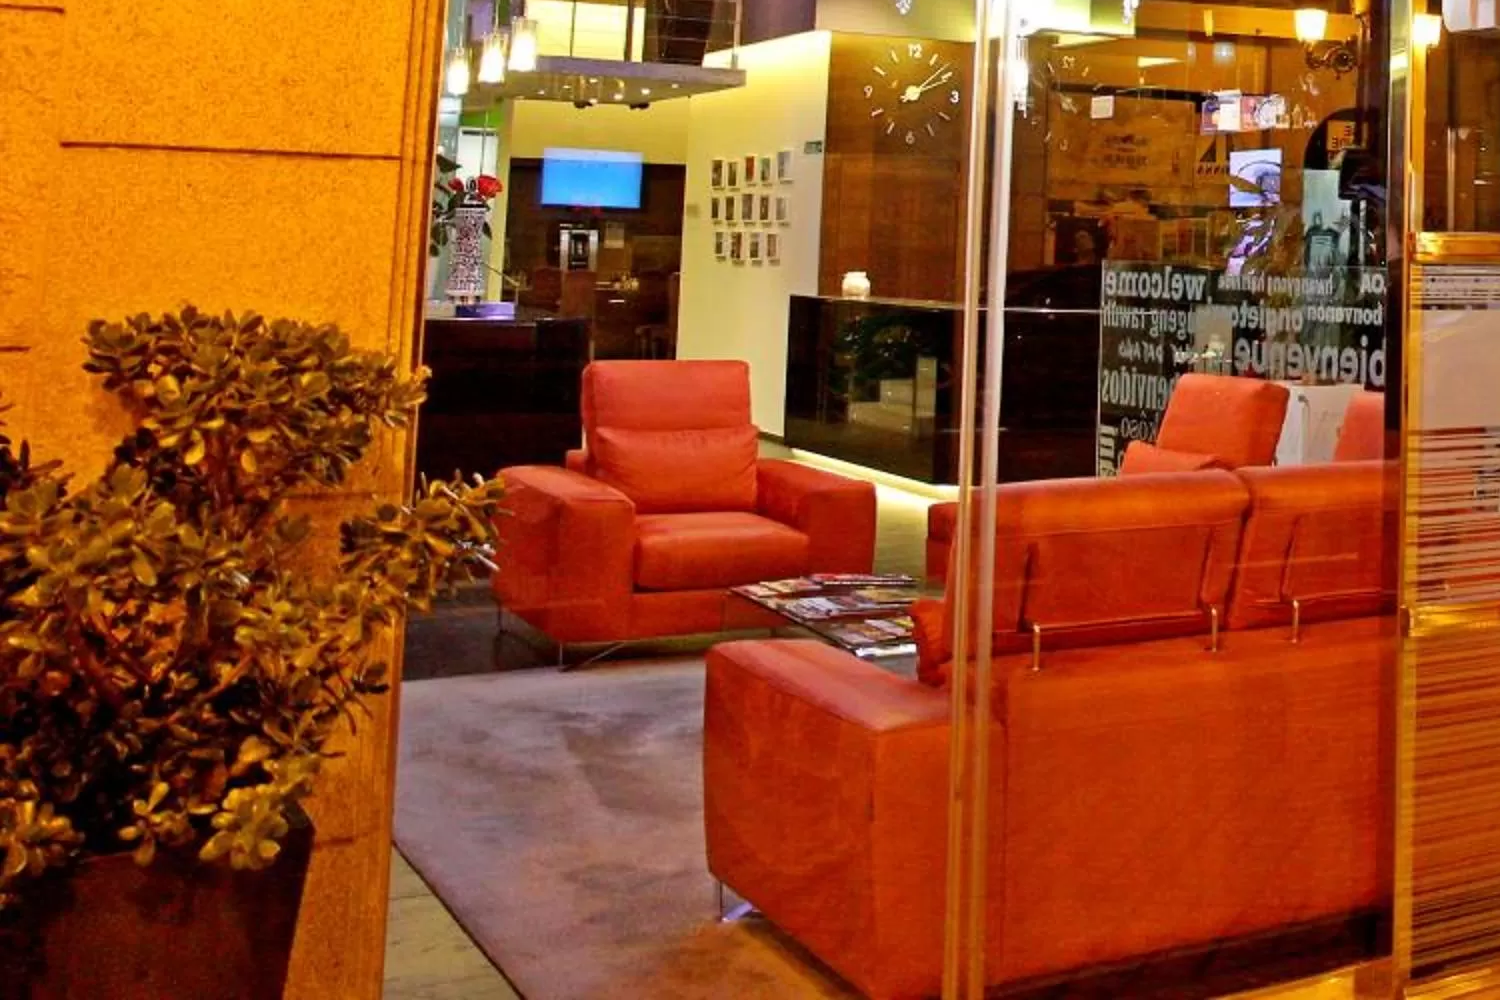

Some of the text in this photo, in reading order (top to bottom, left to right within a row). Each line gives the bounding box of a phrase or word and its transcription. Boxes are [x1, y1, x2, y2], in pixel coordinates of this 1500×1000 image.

[908, 43, 922, 58] 12
[863, 85, 873, 99] 9
[950, 90, 960, 104] 3
[905, 130, 915, 144] 6
